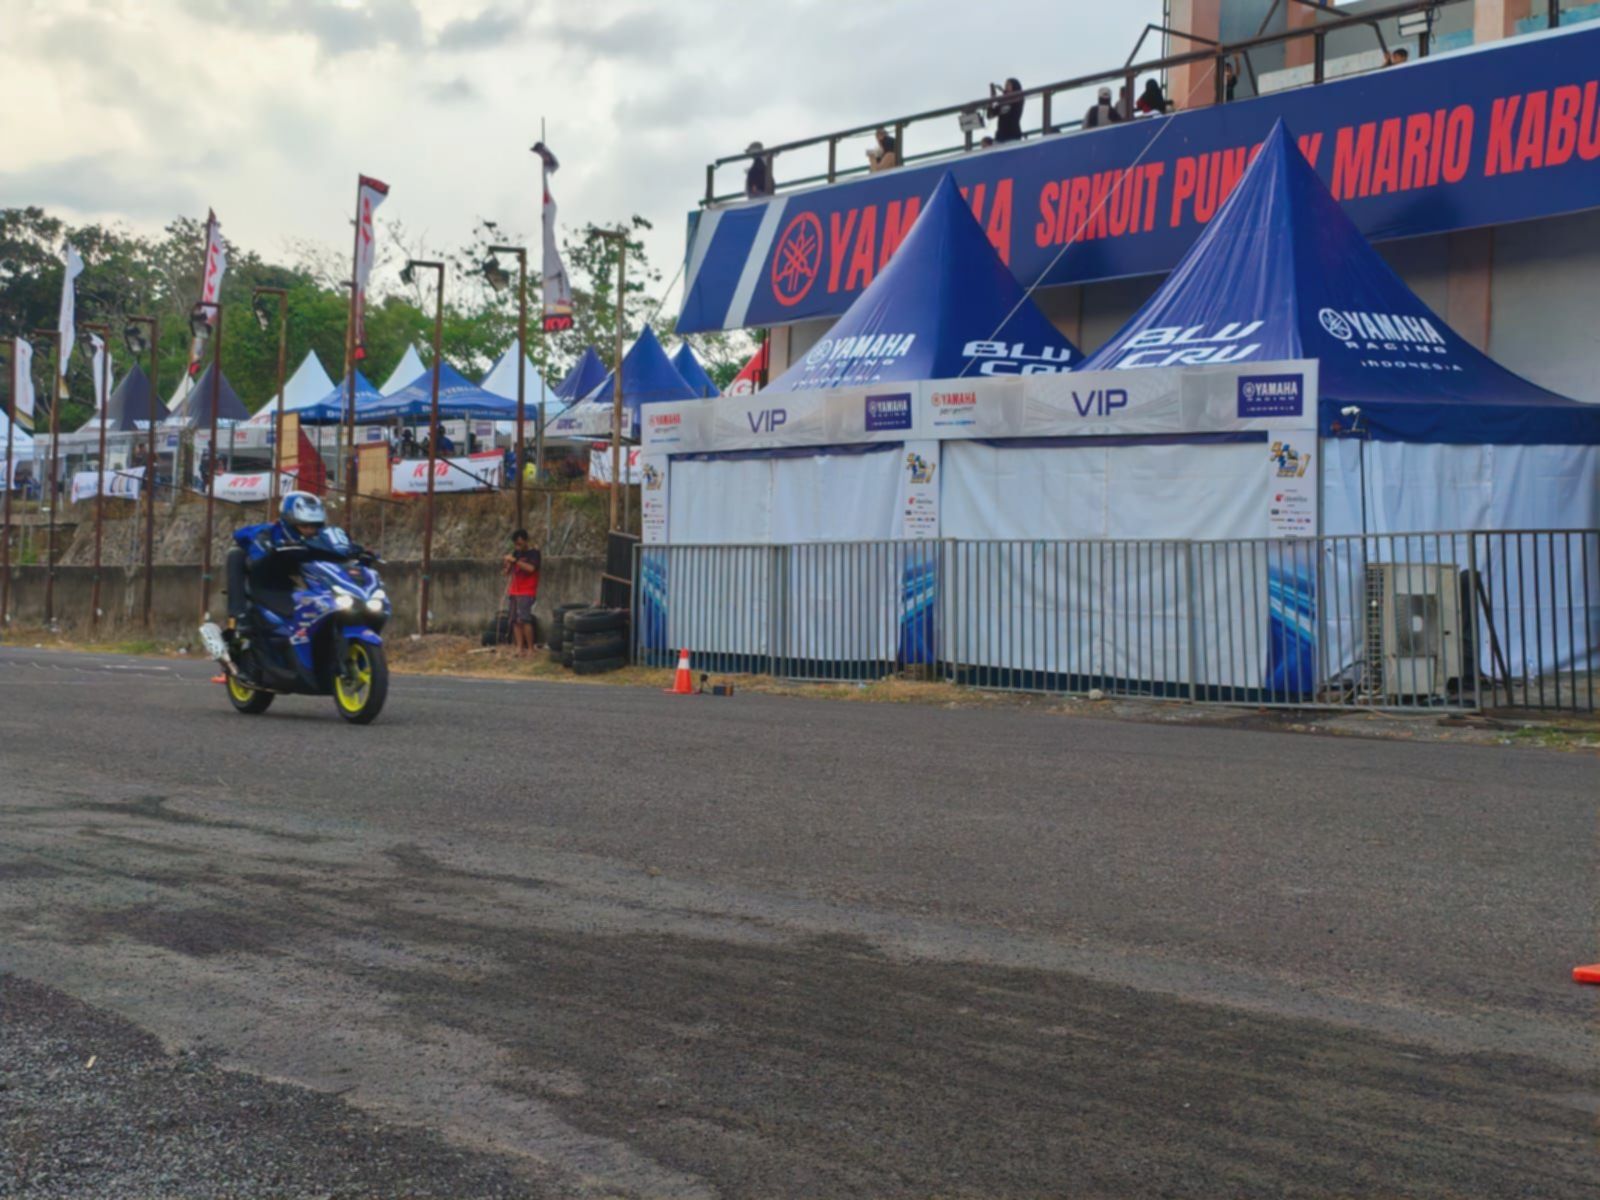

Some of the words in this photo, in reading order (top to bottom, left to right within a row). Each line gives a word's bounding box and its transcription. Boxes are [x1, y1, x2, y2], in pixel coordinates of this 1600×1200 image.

[1035, 162, 1164, 247] SIRKUIT
[1330, 104, 1474, 202] MARIO
[1120, 320, 1265, 350] BLU
[1342, 310, 1447, 345] YAMAHA
[829, 333, 916, 361] YAMAHA
[962, 340, 1072, 363] BLU
[1114, 344, 1263, 370] CRU
[1345, 341, 1448, 354] RACING
[941, 392, 977, 406] YAMAHA
[1255, 381, 1298, 396] YAMAHA
[1072, 388, 1129, 417] VIP
[747, 408, 788, 434] VIP
[323, 527, 349, 546] 16
